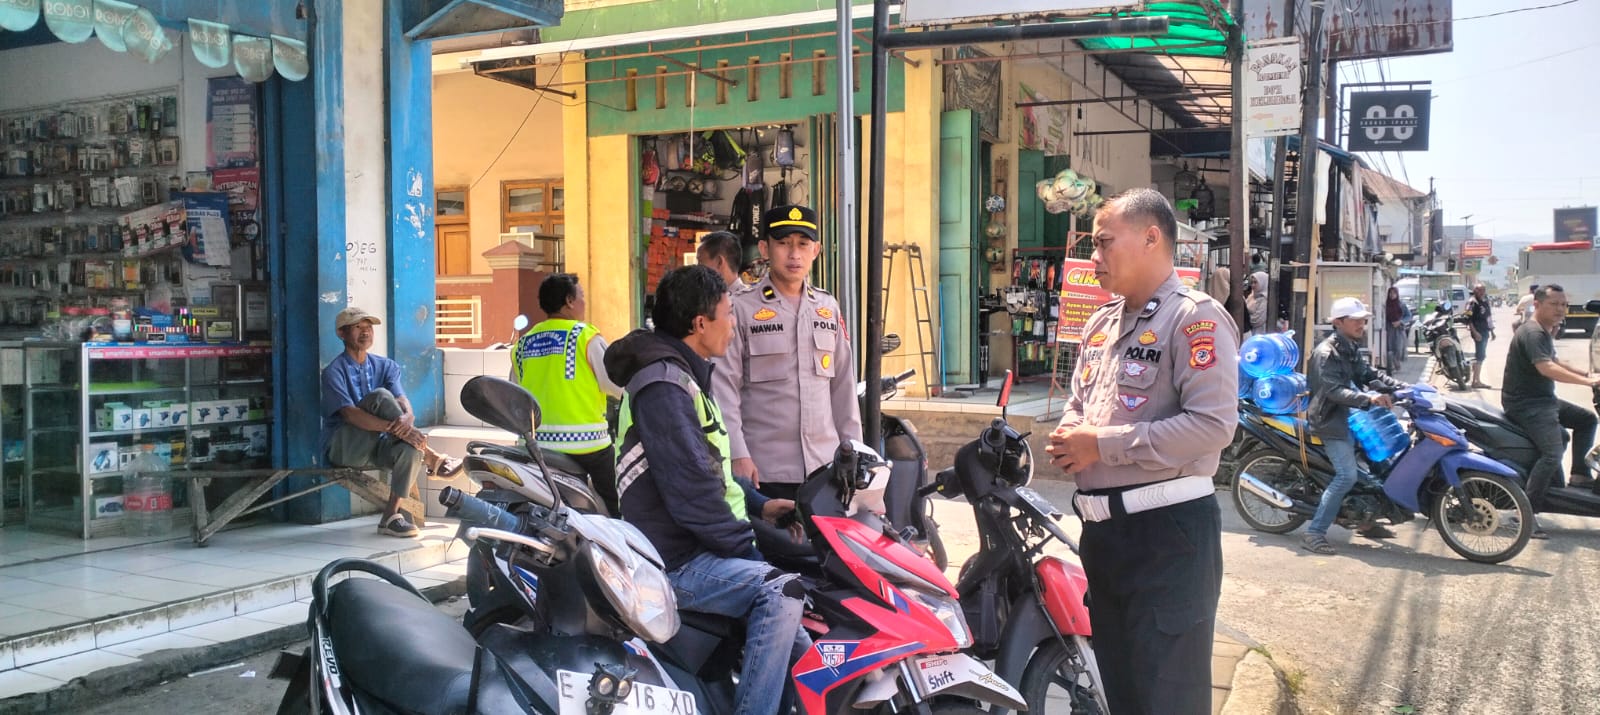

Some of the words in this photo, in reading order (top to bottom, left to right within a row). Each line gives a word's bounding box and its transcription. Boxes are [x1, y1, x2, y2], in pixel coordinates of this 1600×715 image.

[752, 203, 760, 224] YONEX
[750, 323, 784, 334] WAWAN
[813, 321, 837, 332] POLRI
[1124, 346, 1162, 363] POLRI
[322, 639, 338, 675] REVO
[560, 673, 574, 698] E
[929, 671, 955, 690] Shift
